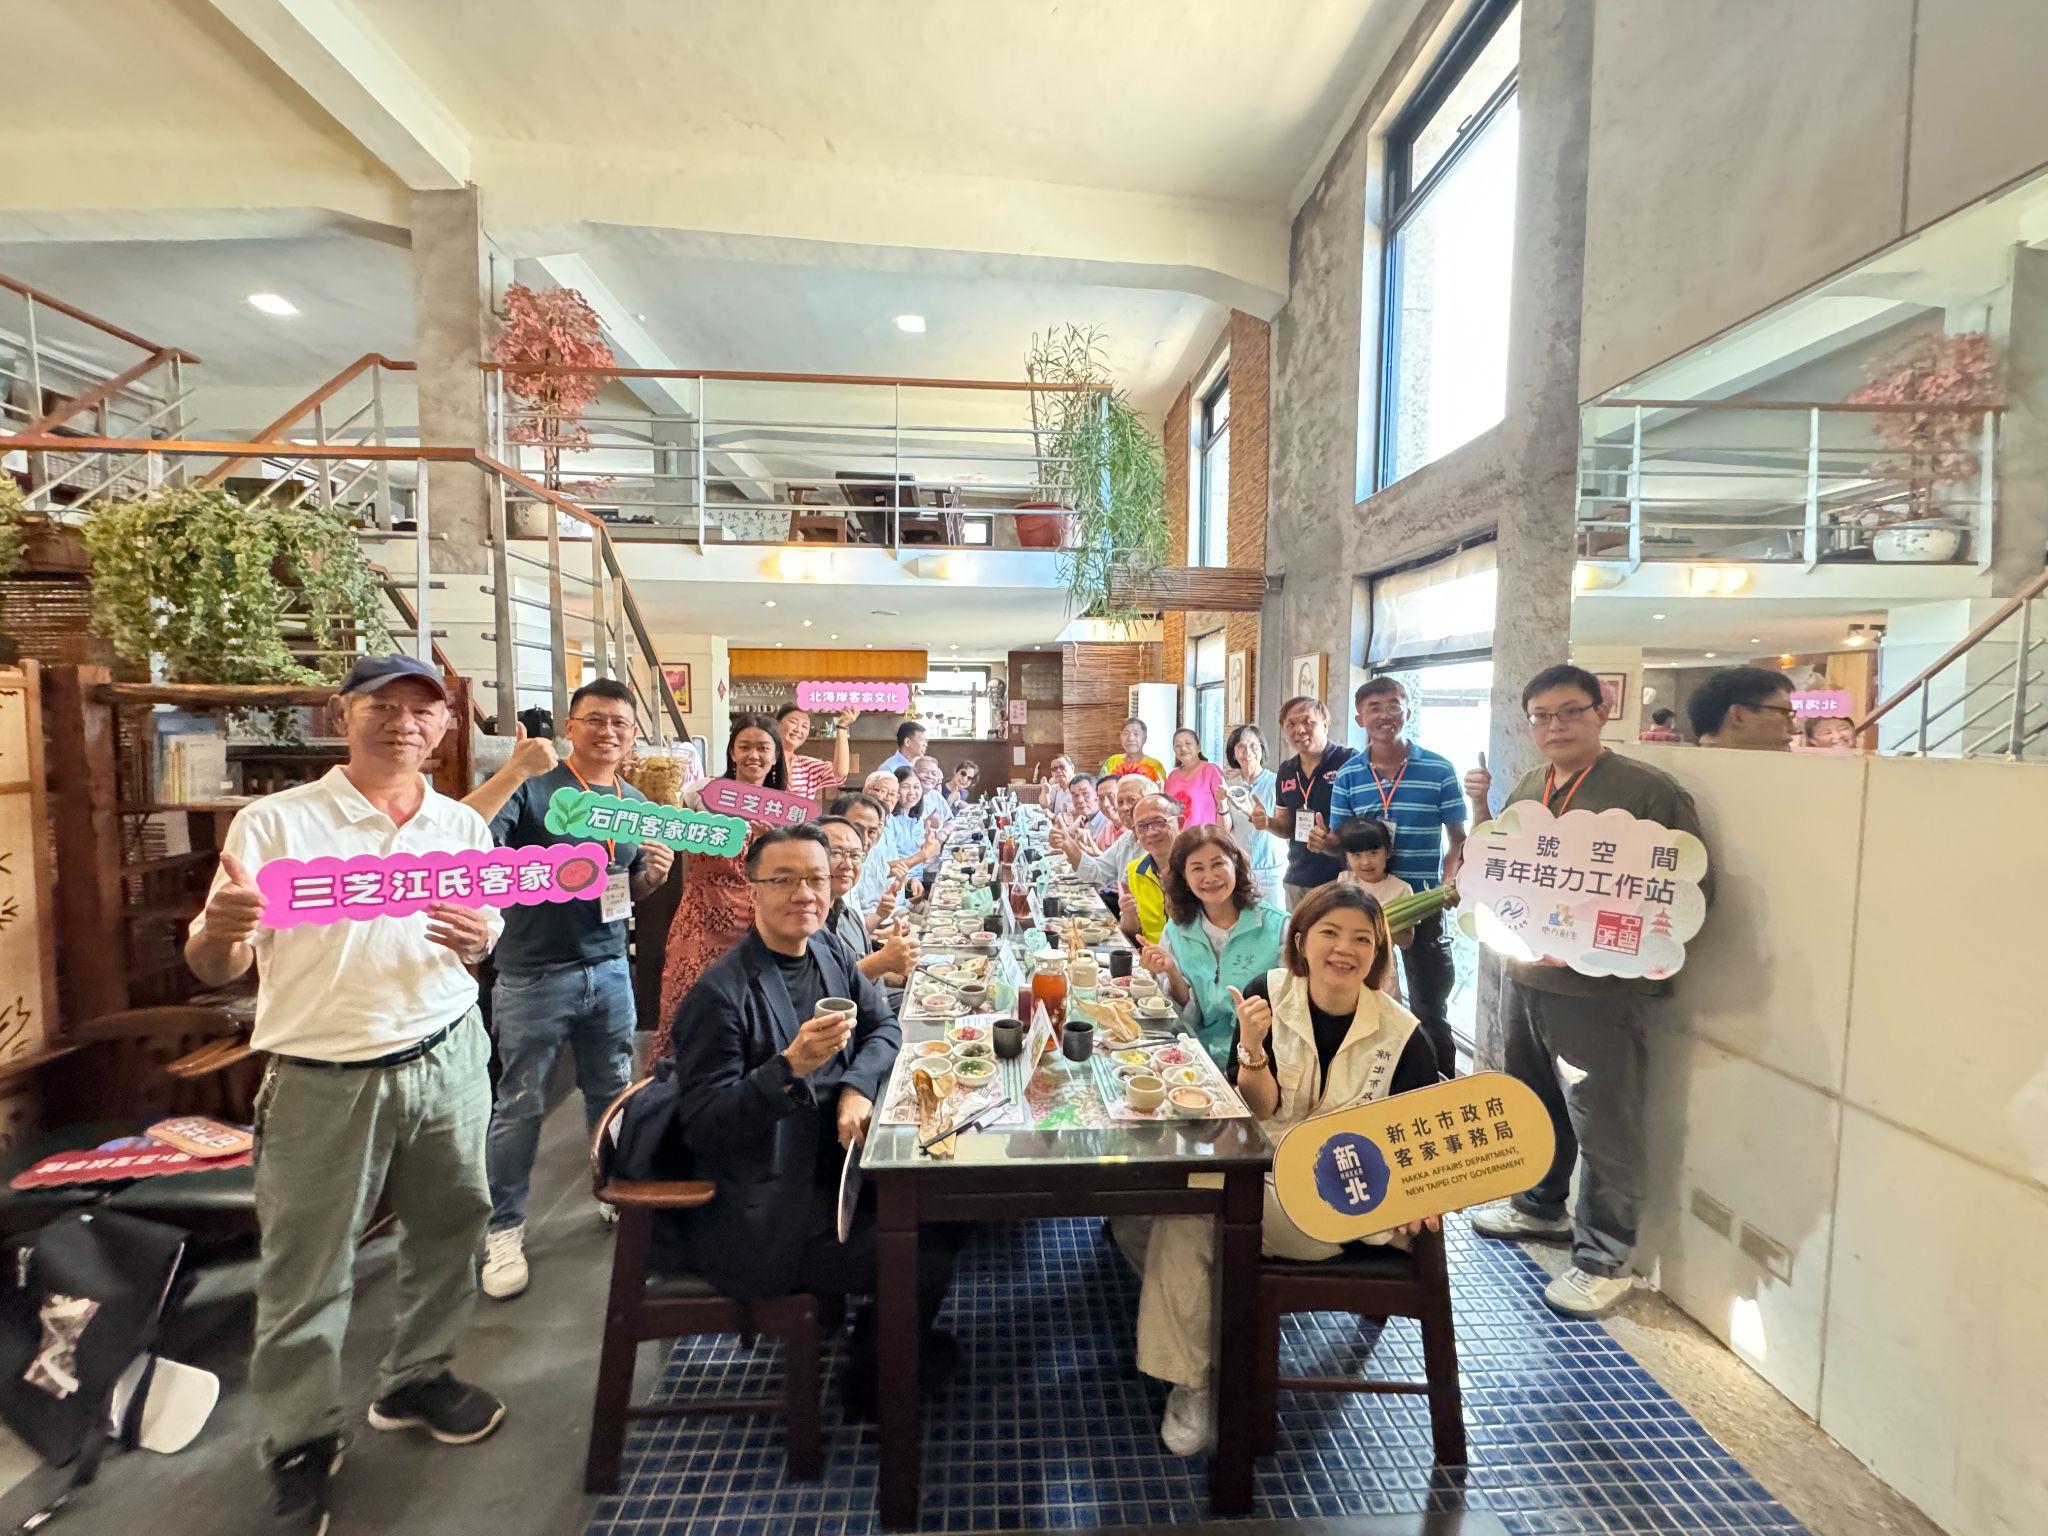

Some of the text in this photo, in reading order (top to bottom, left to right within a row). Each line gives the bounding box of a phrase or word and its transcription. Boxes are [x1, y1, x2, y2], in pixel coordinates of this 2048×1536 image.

[809, 690, 899, 704] 北海岸客家文化
[587, 805, 730, 848] 石門客家好茶
[718, 789, 809, 824] 三芝共創
[290, 861, 554, 910] 三芝江氏客家
[1484, 857, 1676, 906] 青年培力工作站
[1356, 1049, 1391, 1106] 新北市政
[1386, 1096, 1505, 1146] 新北市政府
[1332, 1143, 1361, 1172] 新
[1394, 1121, 1514, 1169] 客家事務局
[1345, 1177, 1371, 1205] 北
[1401, 1171, 1430, 1184] HAKKA
[1432, 1160, 1464, 1176] AFFAIRS
[1405, 1157, 1525, 1196] NEW TAIPEI CITY GOVERNMENT
